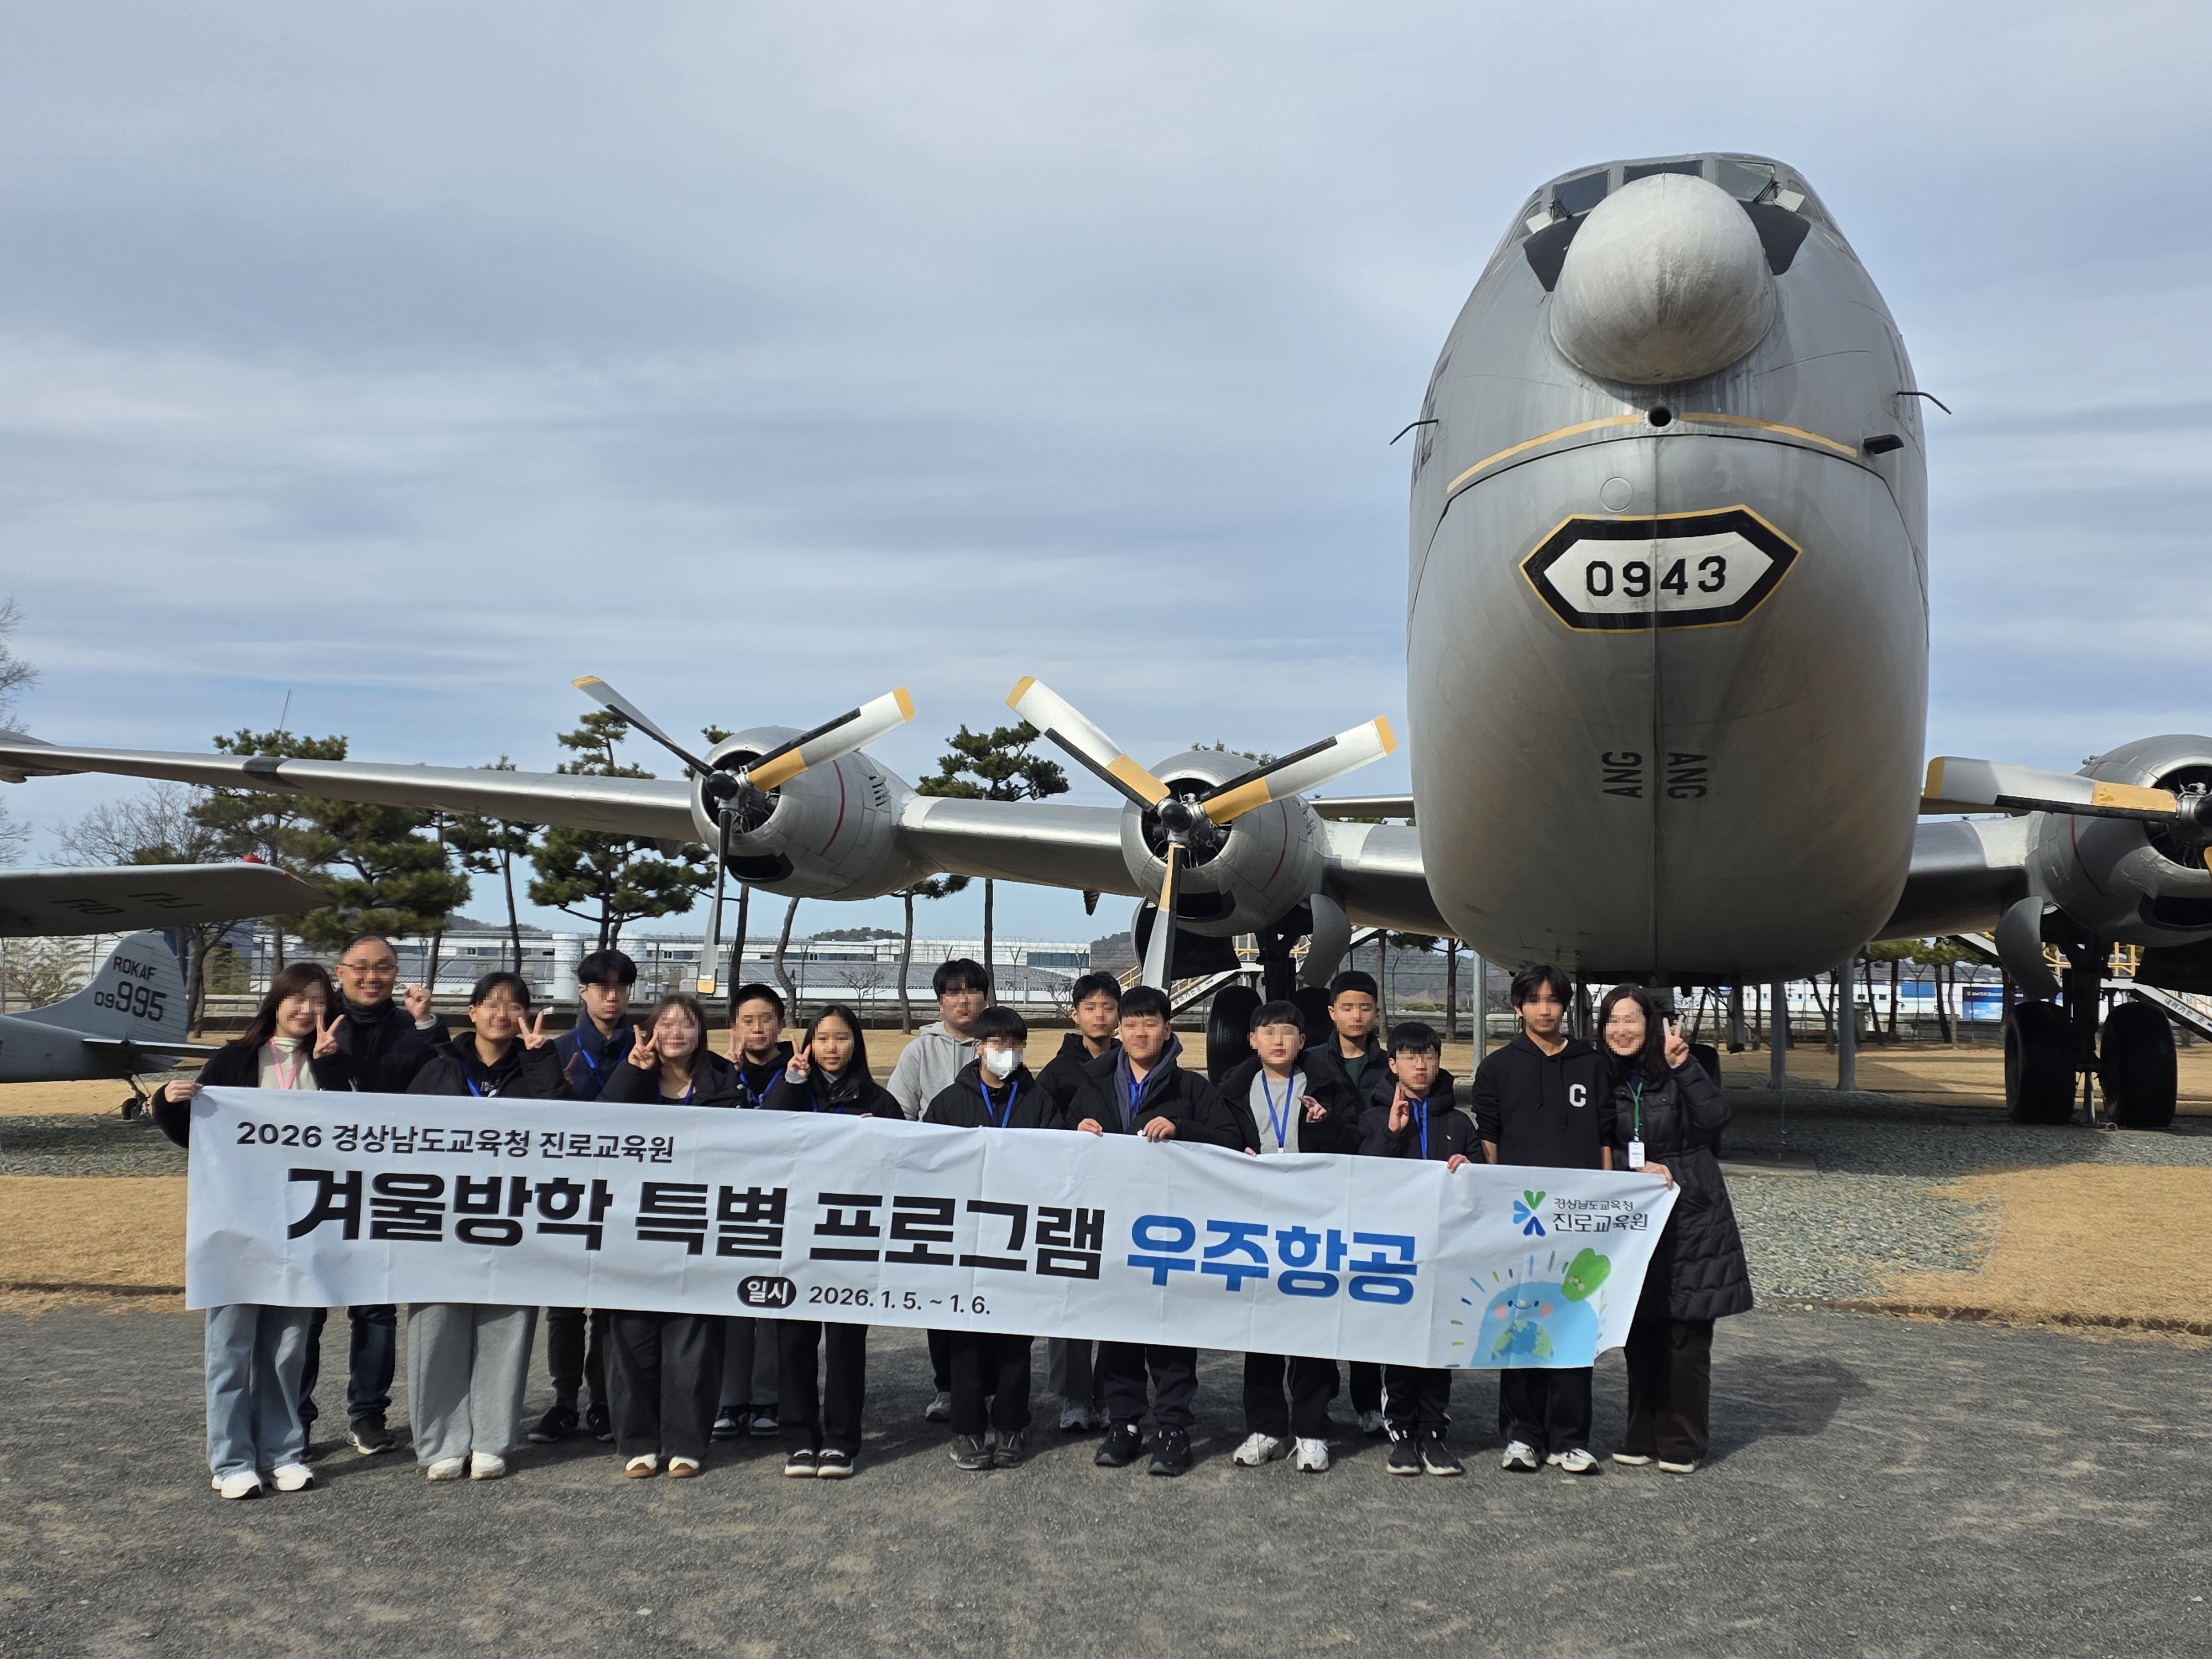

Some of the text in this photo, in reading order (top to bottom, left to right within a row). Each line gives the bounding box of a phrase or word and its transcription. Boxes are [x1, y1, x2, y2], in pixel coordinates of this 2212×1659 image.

[1585, 555, 1727, 598] 0943
[1601, 751, 1643, 799] ANG
[1667, 752, 1708, 800] ANG
[113, 956, 157, 982] ROKAF
[2164, 997, 2193, 1016] 내려가는
[1569, 1083, 1587, 1107] C
[236, 1121, 674, 1164] 2026 경상남도교육청 진로교육원
[1553, 1198, 1634, 1212] 경상남도교육청
[1553, 1213, 1648, 1233] 진로교육원
[287, 1168, 1418, 1305] 겨울방학 특별 프로그램 우주항공
[747, 1280, 788, 1305] 일시
[808, 1286, 874, 1307] 2026.
